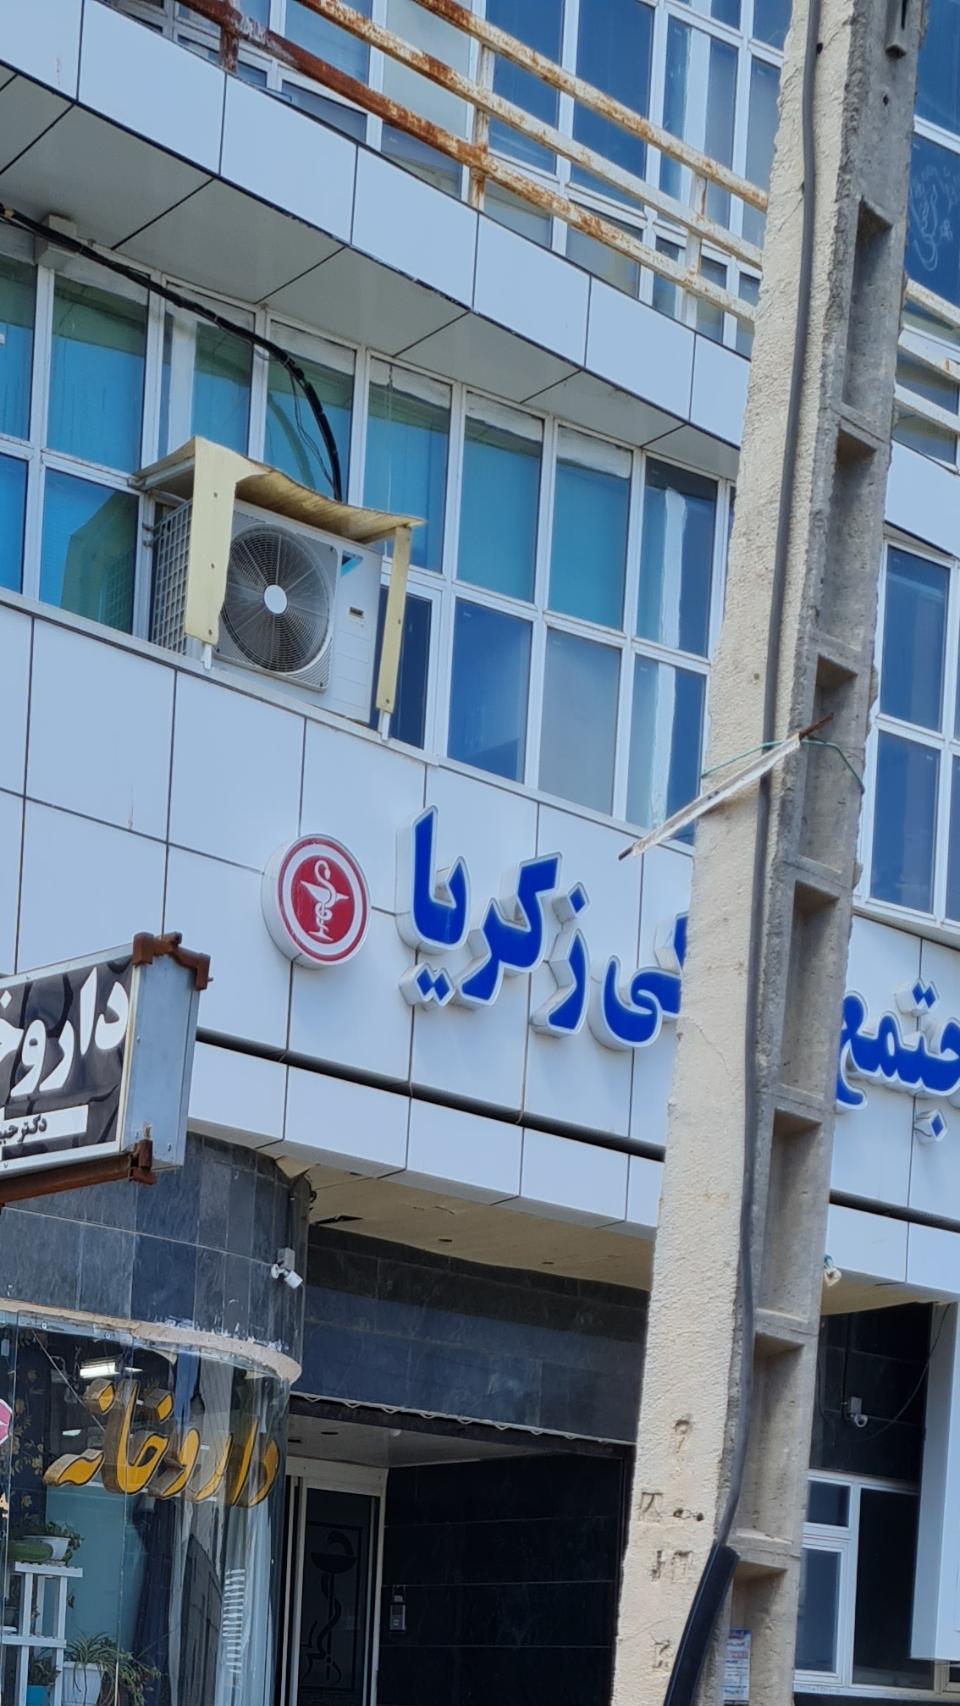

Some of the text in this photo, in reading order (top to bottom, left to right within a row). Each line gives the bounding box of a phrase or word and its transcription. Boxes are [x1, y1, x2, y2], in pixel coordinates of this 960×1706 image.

[412, 806, 590, 1032] زکریا
[18, 1114, 48, 1143] دکتر
[837, 981, 960, 1138] جتمع
